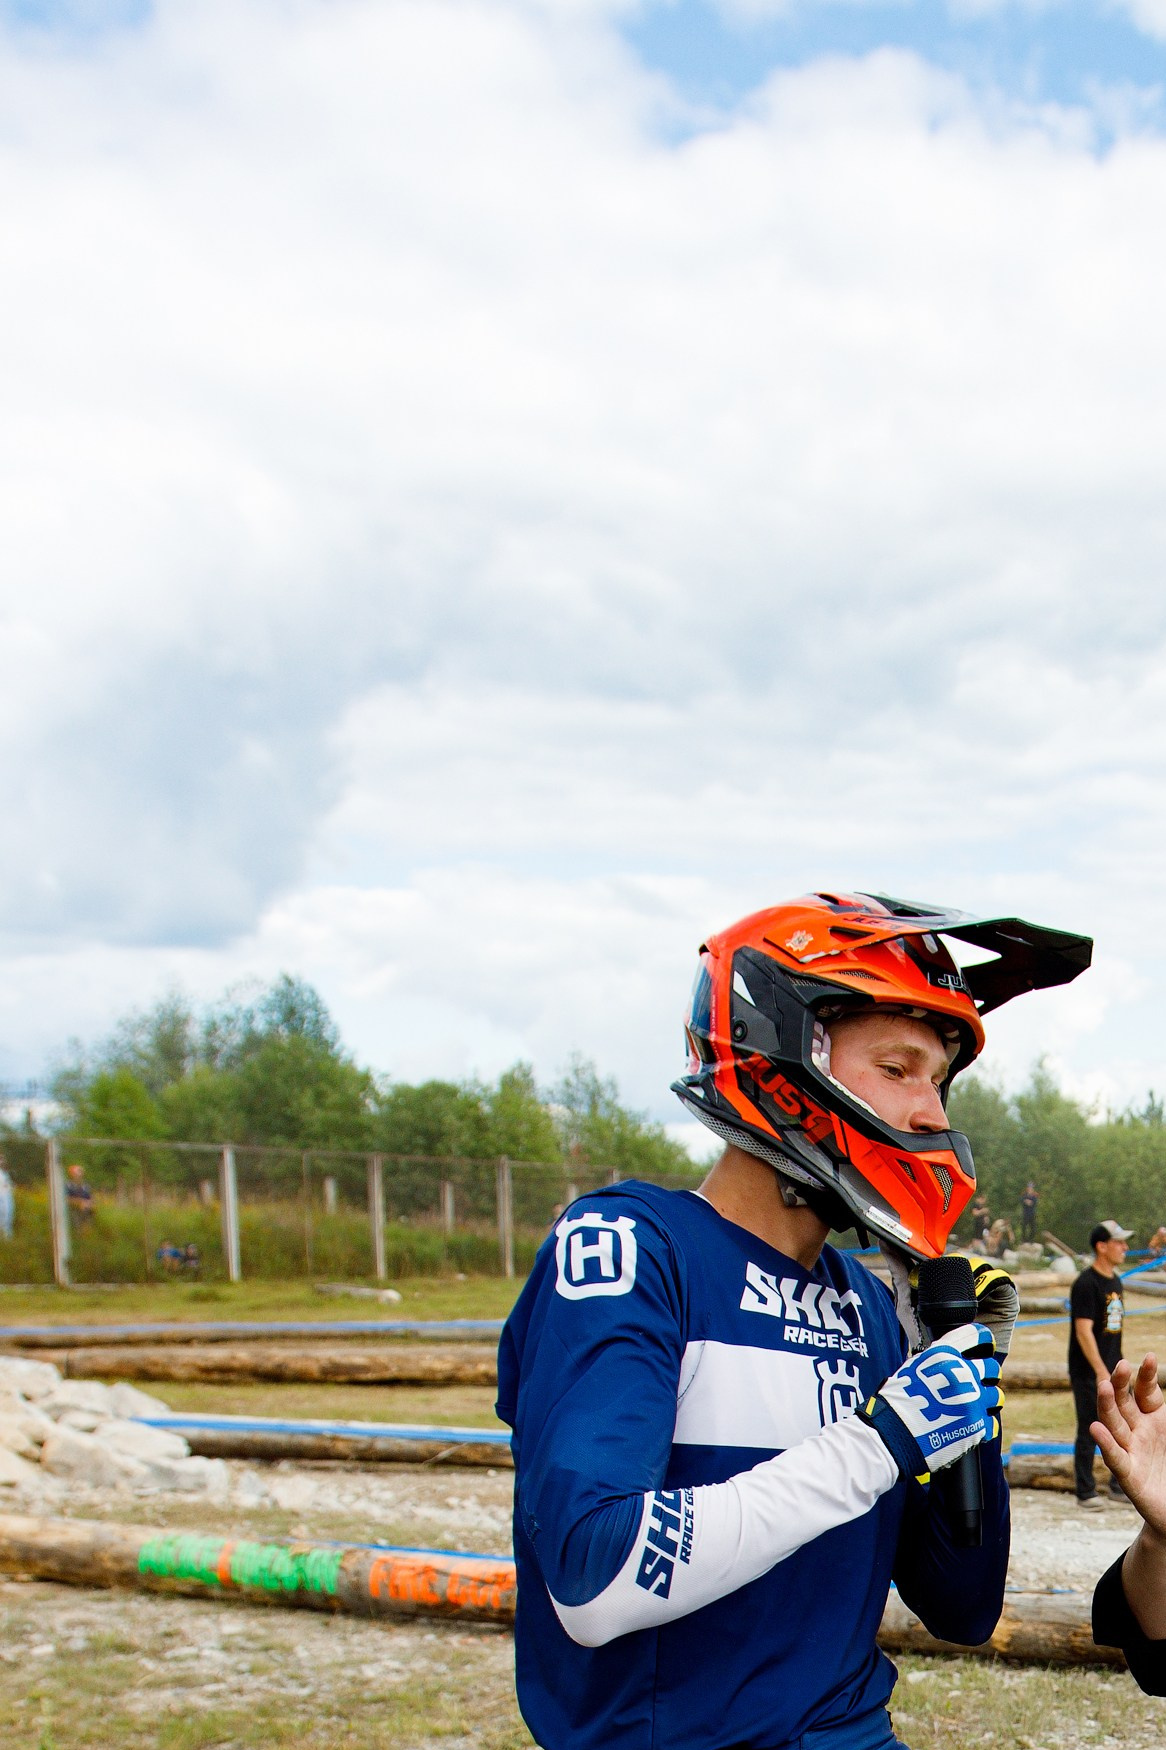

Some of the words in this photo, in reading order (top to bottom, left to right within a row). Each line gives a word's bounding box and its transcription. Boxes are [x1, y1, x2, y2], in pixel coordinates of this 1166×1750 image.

[740, 1261, 865, 1338] SHOT
[784, 1325, 840, 1350] RACE
[942, 1418, 985, 1443] Husqvarna
